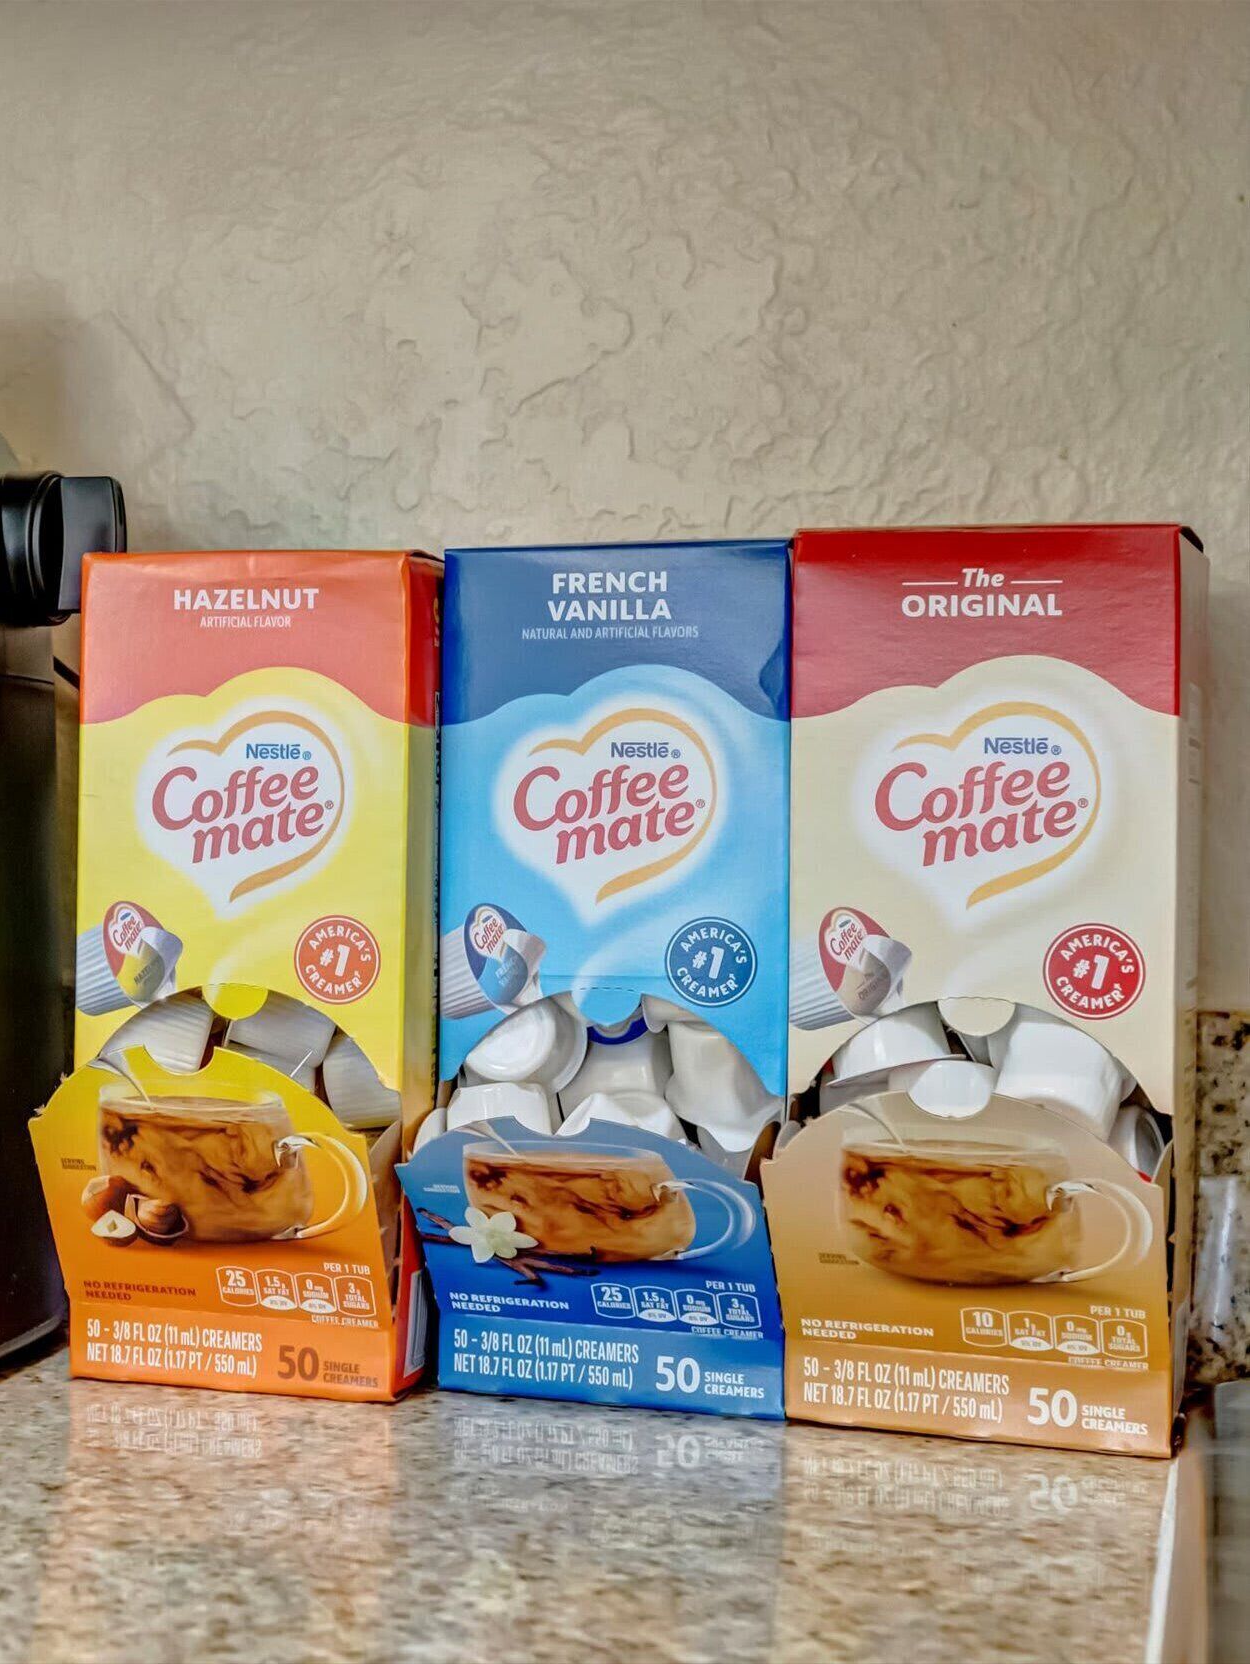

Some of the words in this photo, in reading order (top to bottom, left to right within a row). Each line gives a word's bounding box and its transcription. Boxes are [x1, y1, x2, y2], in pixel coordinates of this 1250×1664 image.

[553, 571, 668, 594] FRENCH
[962, 567, 1004, 588] The
[173, 588, 320, 611] HAZELNUT
[548, 599, 672, 622] VANILLA
[902, 594, 1063, 617] ORIGINAL
[200, 615, 252, 629] ARTIFICIAL
[254, 615, 291, 629] FLAVOR
[522, 627, 568, 641] NATURAL
[570, 627, 592, 640] AND
[595, 626, 650, 640] ARTIFICIAL
[652, 625, 699, 639] FLAVORS
[152, 765, 319, 831] Coffee
[513, 764, 689, 831] Coffee
[874, 760, 1070, 831] Coffee
[113, 915, 137, 947] Coffee
[125, 920, 142, 951] mate
[474, 917, 498, 950] Coffee
[486, 924, 504, 954] mate
[830, 923, 857, 956] Coffee
[309, 926, 372, 963] AMERICA'S
[680, 927, 748, 965] AMERICA'S
[844, 930, 864, 961] mate
[1059, 933, 1135, 975] AMERICA'S
[319, 944, 350, 977] #1
[692, 946, 725, 979] #1
[1072, 954, 1110, 990] #1
[225, 1270, 245, 1287] 25
[324, 1262, 341, 1273] PER
[344, 1264, 349, 1273] 1
[352, 1264, 370, 1275] TUB
[84, 1280, 100, 1289] NO
[104, 1281, 196, 1297] REFRIGERATION
[86, 1290, 131, 1301] NEEDED
[601, 1287, 622, 1302] 25
[705, 1280, 725, 1291] PER
[728, 1282, 733, 1291] 1
[735, 1283, 756, 1293] TUB
[450, 1292, 468, 1301] NO
[471, 1293, 570, 1310] REFRIGERATION
[452, 1302, 501, 1312] NEEDED
[1090, 1305, 1111, 1316] PER
[1115, 1308, 1120, 1317] 1
[1123, 1308, 1146, 1319] TUB
[801, 1318, 821, 1328] NO
[825, 1320, 934, 1337] REFRIGERATION
[972, 1312, 993, 1328] 10
[87, 1318, 100, 1337] 50
[113, 1320, 130, 1341] 3/8
[133, 1322, 145, 1341] FL
[148, 1324, 162, 1343] OZ
[164, 1323, 178, 1347] (11
[181, 1326, 199, 1348] mL)
[203, 1329, 262, 1352] CREAMERS
[802, 1329, 857, 1340] NEEDED
[454, 1329, 467, 1348] 50
[481, 1331, 499, 1353] 3/8
[502, 1333, 514, 1353] FL
[517, 1334, 532, 1354] OZ
[535, 1334, 549, 1357] (11
[552, 1337, 572, 1360] mL)
[575, 1339, 639, 1364] CREAMERS
[87, 1342, 108, 1362] NET
[110, 1344, 130, 1365] 18.7
[133, 1347, 145, 1366] FL
[148, 1348, 162, 1367] OZ
[164, 1347, 186, 1370] (1.17
[189, 1351, 203, 1371] PT
[214, 1354, 234, 1374] 550
[237, 1355, 256, 1378] mL)
[277, 1345, 319, 1381] 50
[323, 1361, 360, 1374] SINGLE
[323, 1374, 378, 1388] CREAMERS
[454, 1353, 476, 1372] NET
[478, 1356, 499, 1376] 18.7
[502, 1358, 514, 1377] FL
[517, 1359, 532, 1379] OZ
[535, 1358, 558, 1382] (1.17
[561, 1362, 575, 1383] PT
[588, 1366, 609, 1386] 550
[612, 1367, 632, 1391] mL)
[656, 1356, 700, 1393] 50
[705, 1371, 744, 1385] SINGLE
[804, 1357, 819, 1377] 50
[834, 1359, 854, 1382] 3/8
[858, 1362, 872, 1382] FL
[875, 1363, 891, 1384] OZ
[894, 1362, 910, 1386] (11
[913, 1367, 936, 1390] mL)
[939, 1369, 1010, 1396] CREAMERS
[704, 1384, 764, 1399] CREAMERS
[804, 1382, 828, 1402] NET
[831, 1385, 853, 1407] 18.7
[858, 1387, 872, 1407] FL
[875, 1388, 891, 1409] OZ
[894, 1388, 919, 1413] (1.17
[923, 1393, 939, 1415] PT
[953, 1397, 976, 1419] 550
[979, 1398, 1002, 1423] mL)
[1027, 1387, 1078, 1428] 50
[1082, 1404, 1126, 1419] SINGLE
[1082, 1419, 1148, 1436] CREAMERS
